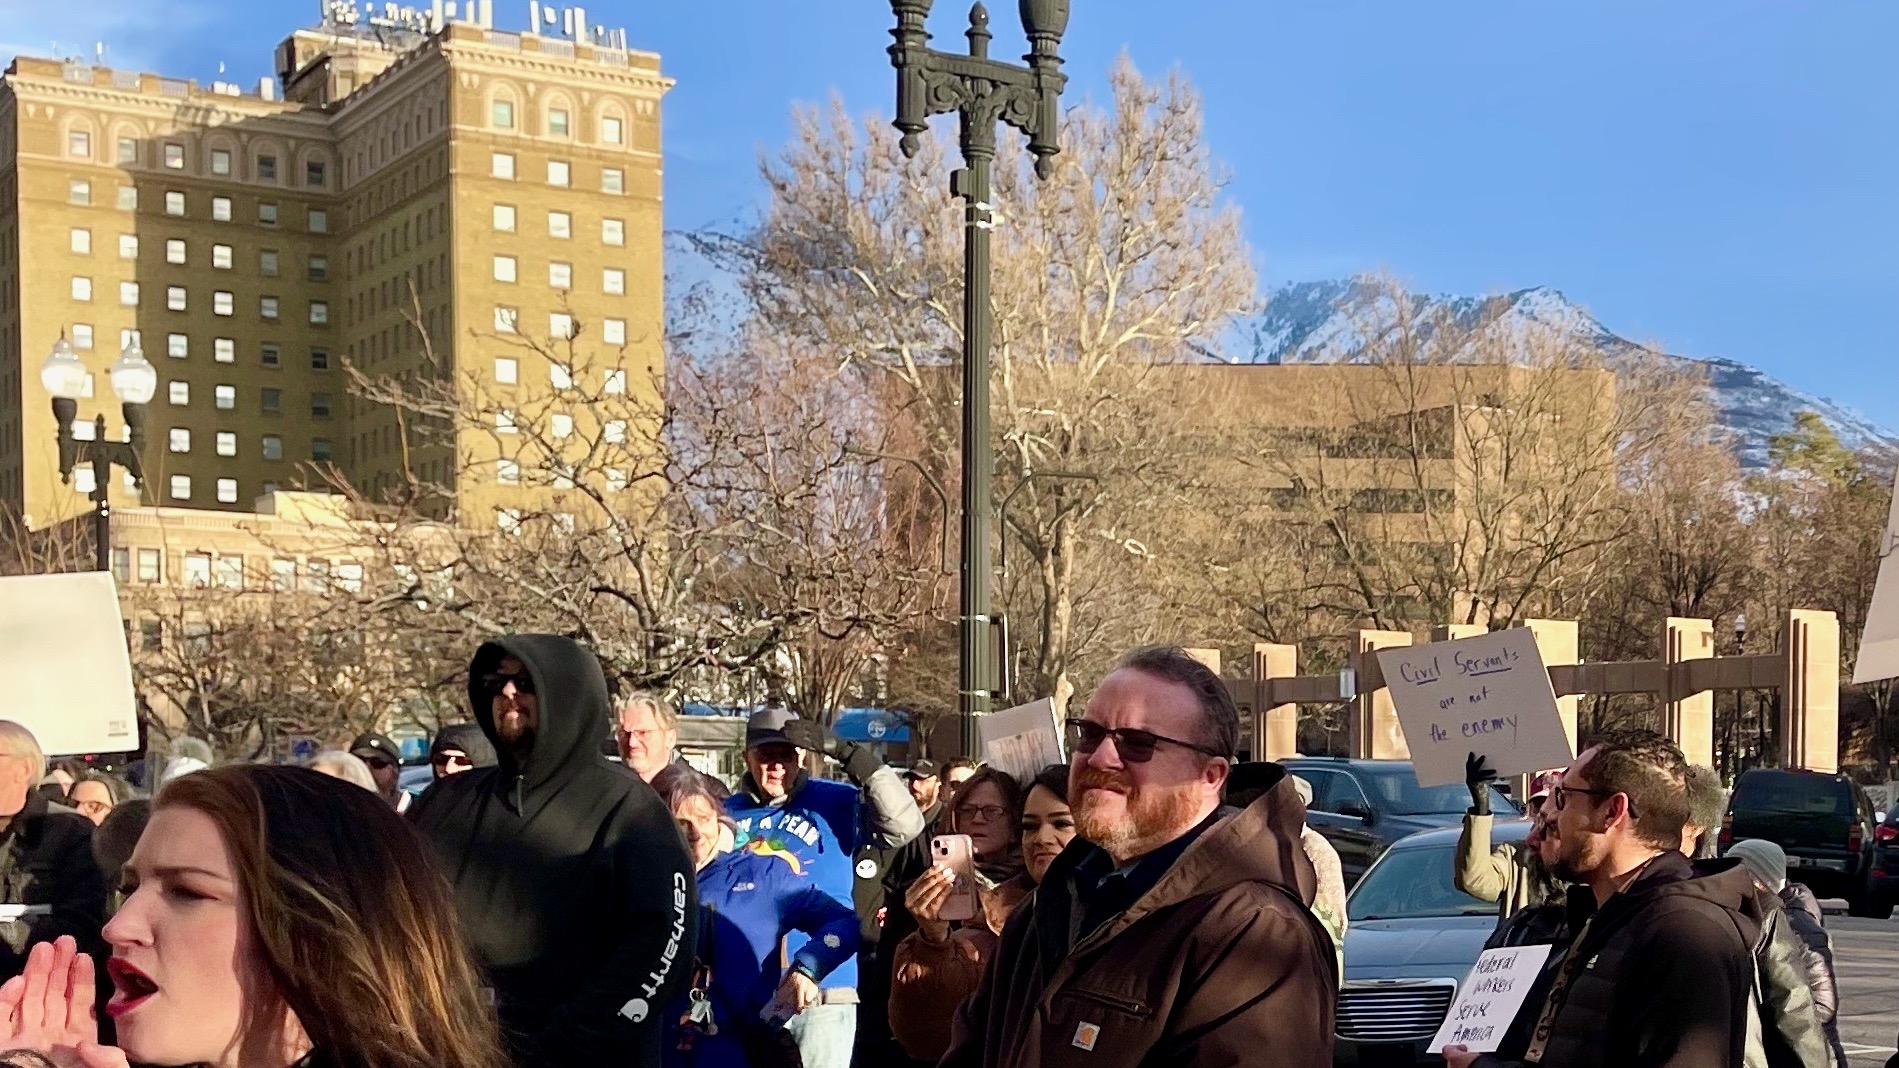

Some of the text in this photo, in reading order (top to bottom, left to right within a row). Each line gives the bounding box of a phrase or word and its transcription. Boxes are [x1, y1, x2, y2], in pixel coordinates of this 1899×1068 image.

[1400, 647, 1520, 683] Civil Servants
[1439, 685, 1491, 710] are not
[1429, 713, 1519, 751] the enemy
[641, 872, 687, 998] carhartt
